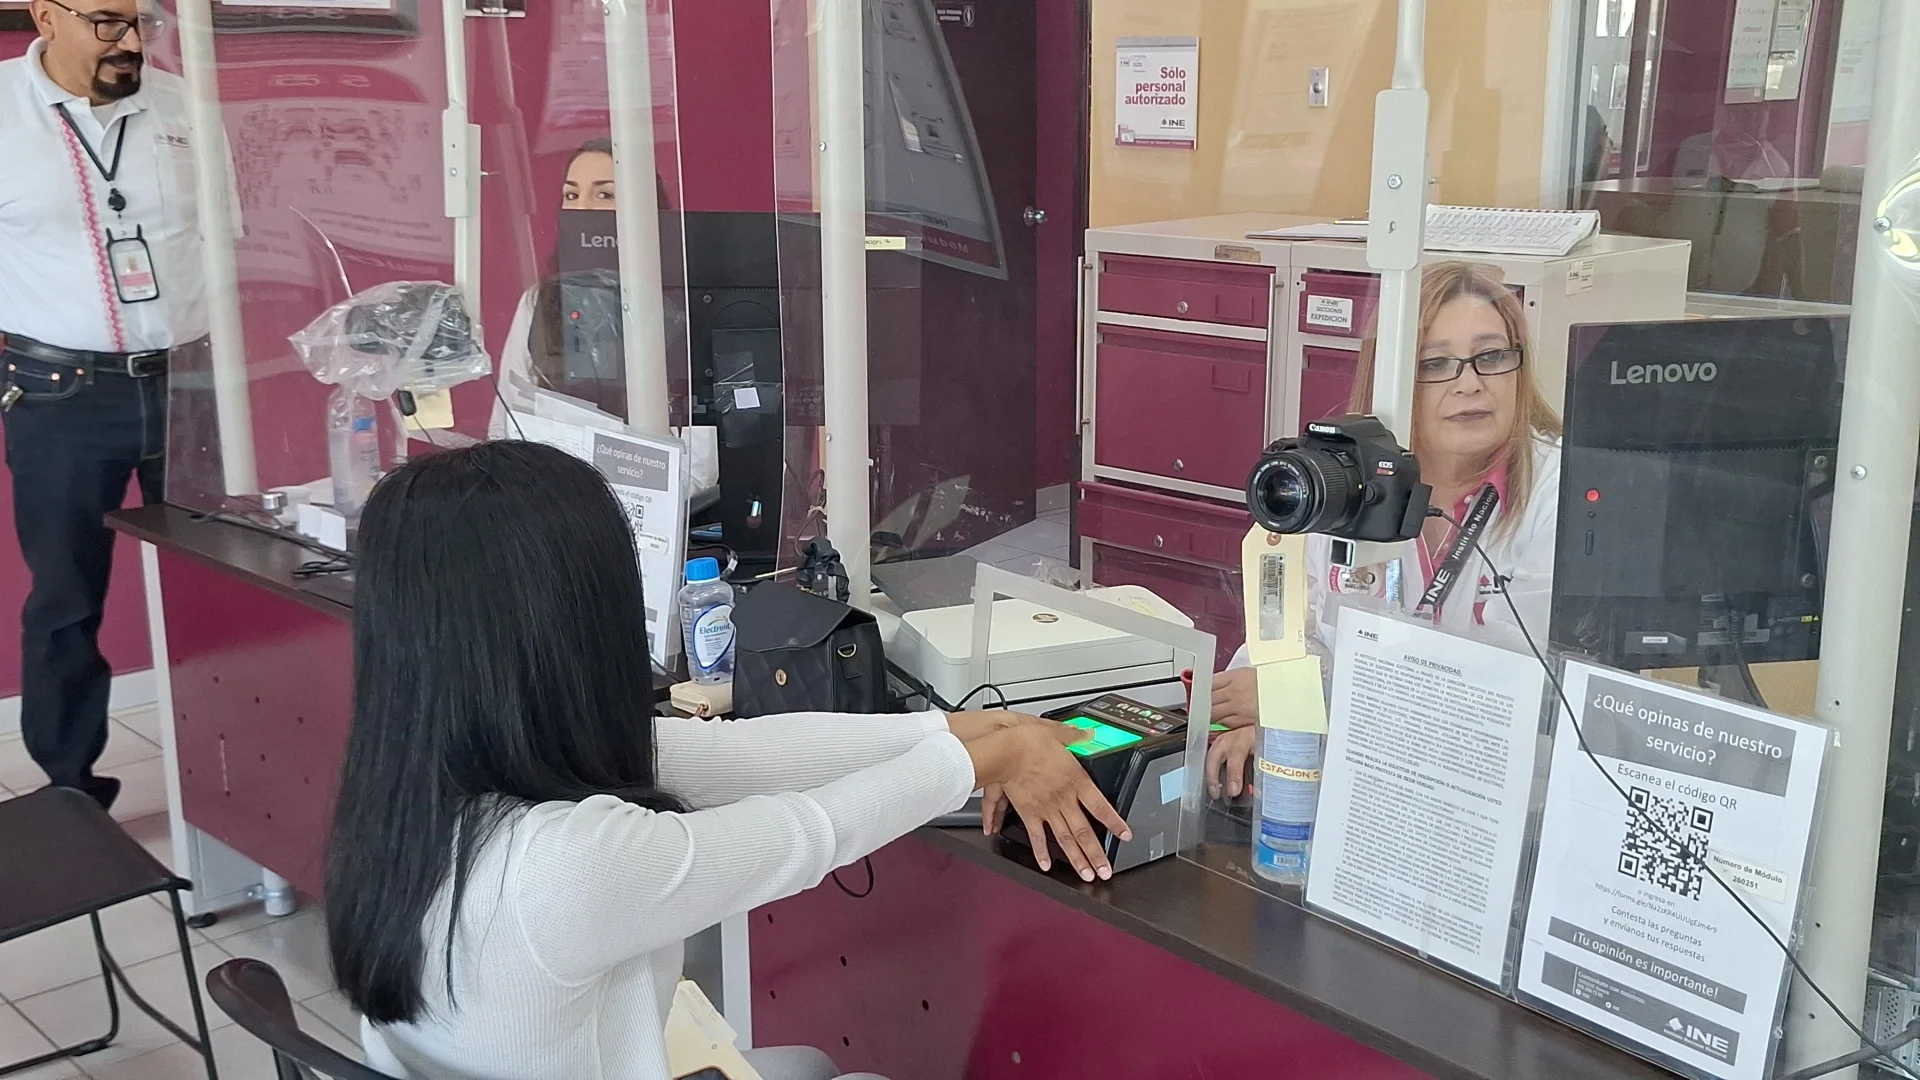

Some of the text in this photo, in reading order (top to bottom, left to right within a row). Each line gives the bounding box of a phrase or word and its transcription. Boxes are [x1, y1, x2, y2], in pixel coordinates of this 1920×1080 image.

[1160, 66, 1186, 79] Sólo
[1135, 80, 1186, 94] personal
[1125, 93, 1186, 106] autorizado
[1610, 360, 1718, 385] Lenovo
[1309, 423, 1336, 434] Canon
[613, 450, 632, 462] opinas
[634, 452, 642, 464] de
[642, 457, 666, 470] nuestro
[1378, 461, 1394, 469] EOS
[617, 465, 644, 478] servicio?
[1452, 522, 1478, 561] Institto
[1425, 568, 1451, 603] INE
[1363, 631, 1378, 640] INE
[1404, 655, 1419, 664] AVISO
[1420, 658, 1428, 666] DE
[1594, 694, 1782, 758] ¿Qué opinas de nuestro
[1646, 736, 1716, 764] servicio?
[1260, 760, 1310, 779] ESTACION
[1618, 764, 1736, 810] Escanea el código QR
[1714, 856, 1741, 870] Número
[1755, 869, 1782, 883] Módulo
[1644, 892, 1665, 903] ingresa
[1612, 906, 1701, 946] Contesta las preguntas
[1647, 934, 1659, 944] tus
[1662, 940, 1704, 962] respuestas
[1573, 932, 1718, 997] ¡Tu opinión es importante!
[1686, 1025, 1728, 1049] INE
